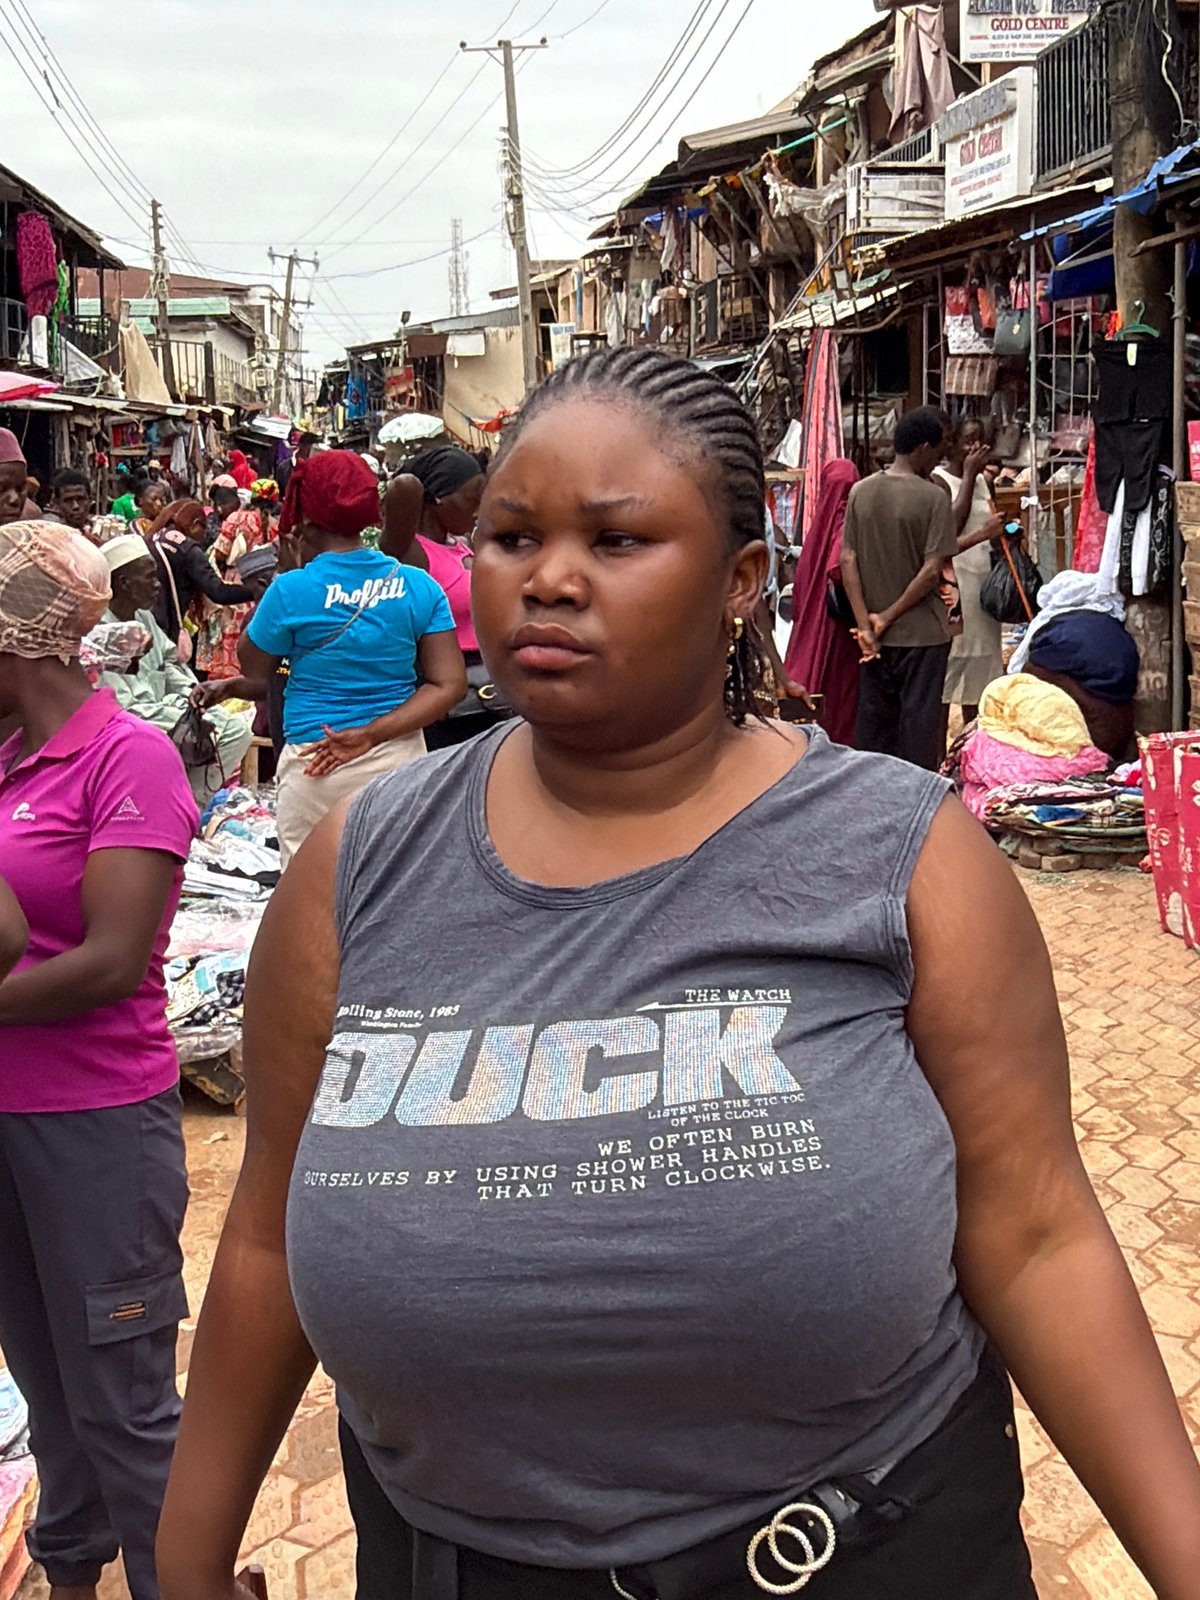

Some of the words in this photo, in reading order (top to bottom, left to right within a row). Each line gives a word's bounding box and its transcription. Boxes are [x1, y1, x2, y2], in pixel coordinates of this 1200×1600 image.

[991, 18, 1023, 31] GOLD
[1025, 17, 1069, 30] CENTRE
[685, 988, 721, 1003] THE
[727, 988, 792, 1002] WATCH
[429, 1004, 460, 1018] 1985
[311, 1006, 802, 1127] DUCK
[648, 1104, 697, 1119] LISTEN
[701, 1102, 719, 1111] TO
[723, 1099, 751, 1109] THE
[756, 1096, 778, 1106] TIC
[780, 1093, 806, 1103] TOC
[671, 1117, 687, 1127] OF
[693, 1112, 721, 1124] THE
[725, 1108, 769, 1120] CLOCK
[598, 1139, 632, 1156] WE
[650, 1127, 733, 1151] OFTEN
[751, 1119, 816, 1140] BURN
[303, 1171, 410, 1187] OURSELVES
[425, 1169, 457, 1185] BY
[476, 1164, 558, 1182] USING
[576, 1152, 683, 1177] SHOWER
[703, 1136, 822, 1164] HANDLES
[477, 1183, 553, 1201] THAT
[571, 1175, 647, 1195] TURN
[665, 1155, 831, 1187] CLOCKWISE.
